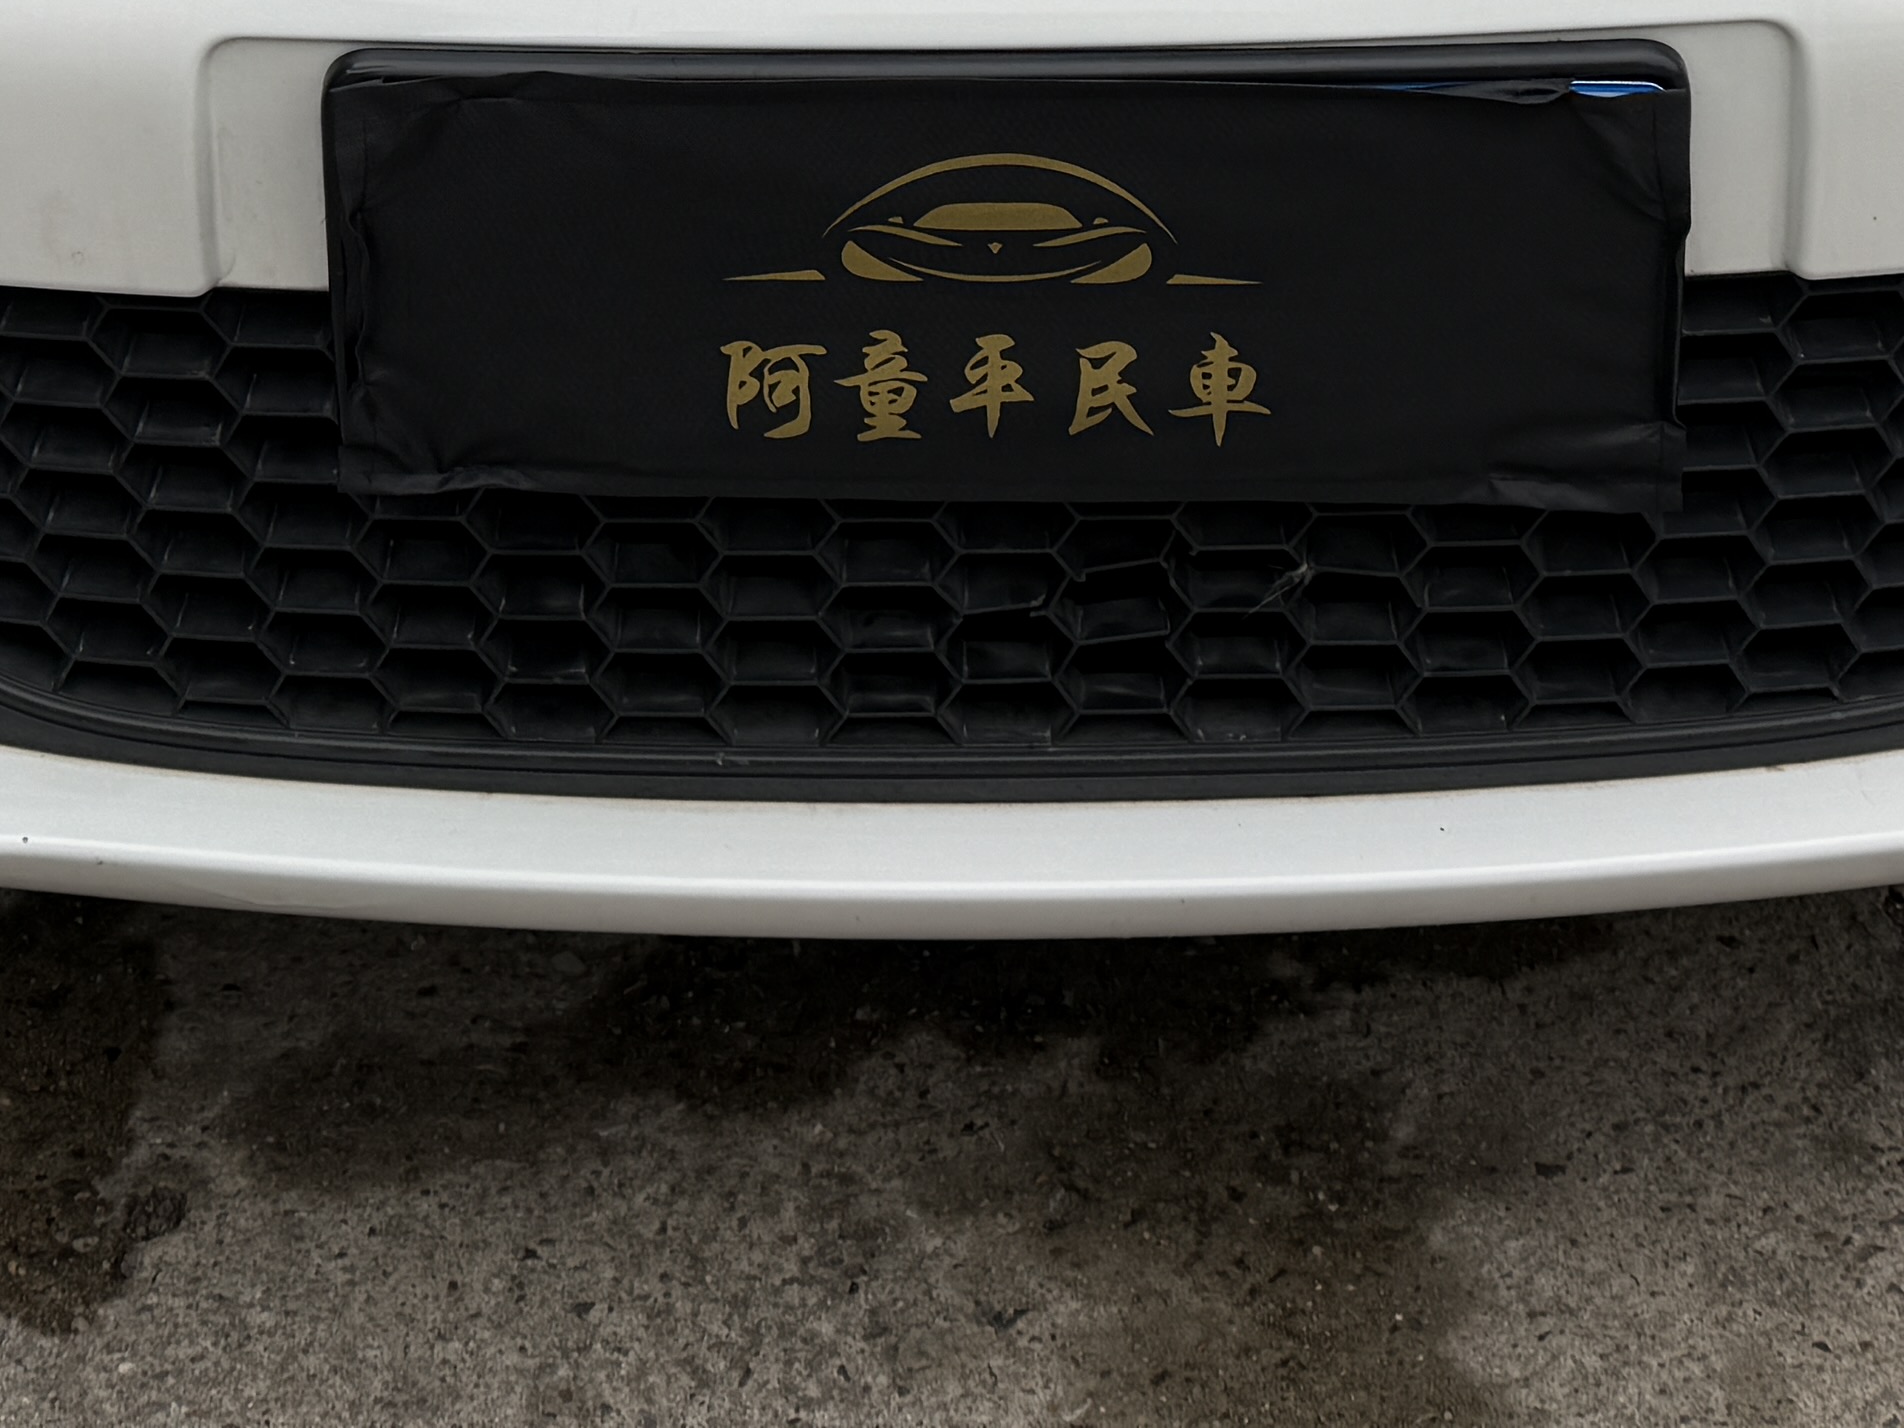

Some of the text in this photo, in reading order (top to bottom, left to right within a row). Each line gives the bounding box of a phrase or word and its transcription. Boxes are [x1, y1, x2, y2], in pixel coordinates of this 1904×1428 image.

[722, 330, 1273, 448] 阿童平民車
